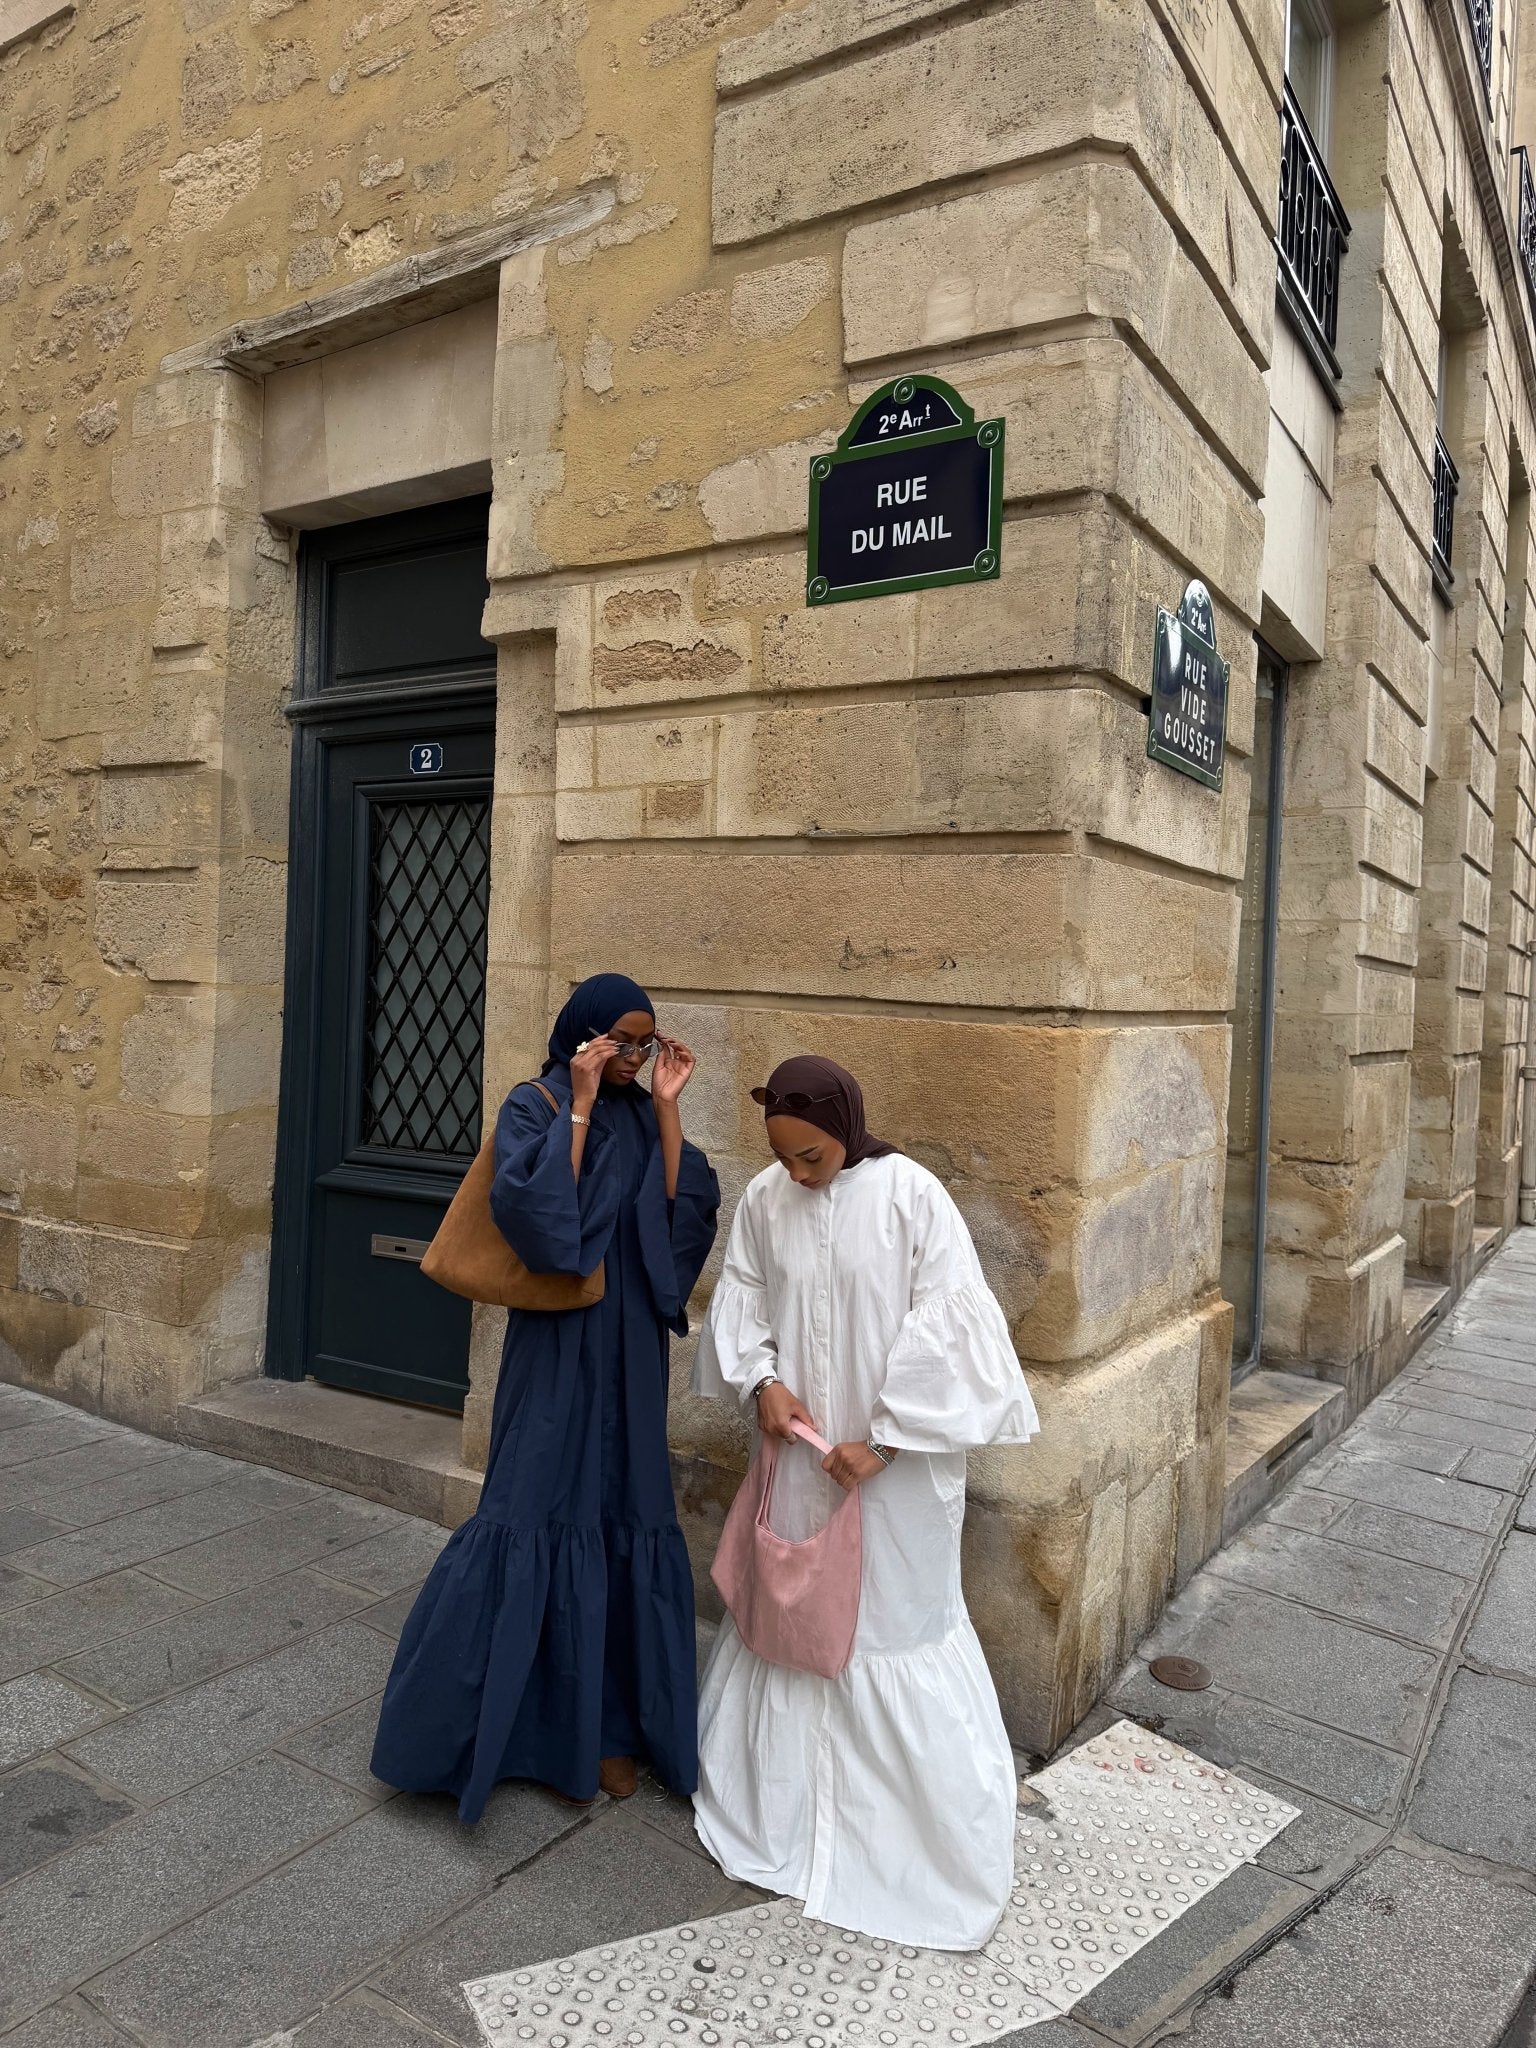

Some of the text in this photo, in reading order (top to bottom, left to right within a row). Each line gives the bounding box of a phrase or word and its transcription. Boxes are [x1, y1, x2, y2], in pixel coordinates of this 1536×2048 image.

[877, 475, 927, 508] RUE
[851, 515, 952, 554] DU MAIL
[1185, 652, 1207, 691] RUE
[1181, 685, 1207, 725] VIDE
[1164, 712, 1216, 764] GOUSSET
[420, 748, 432, 769] 2
